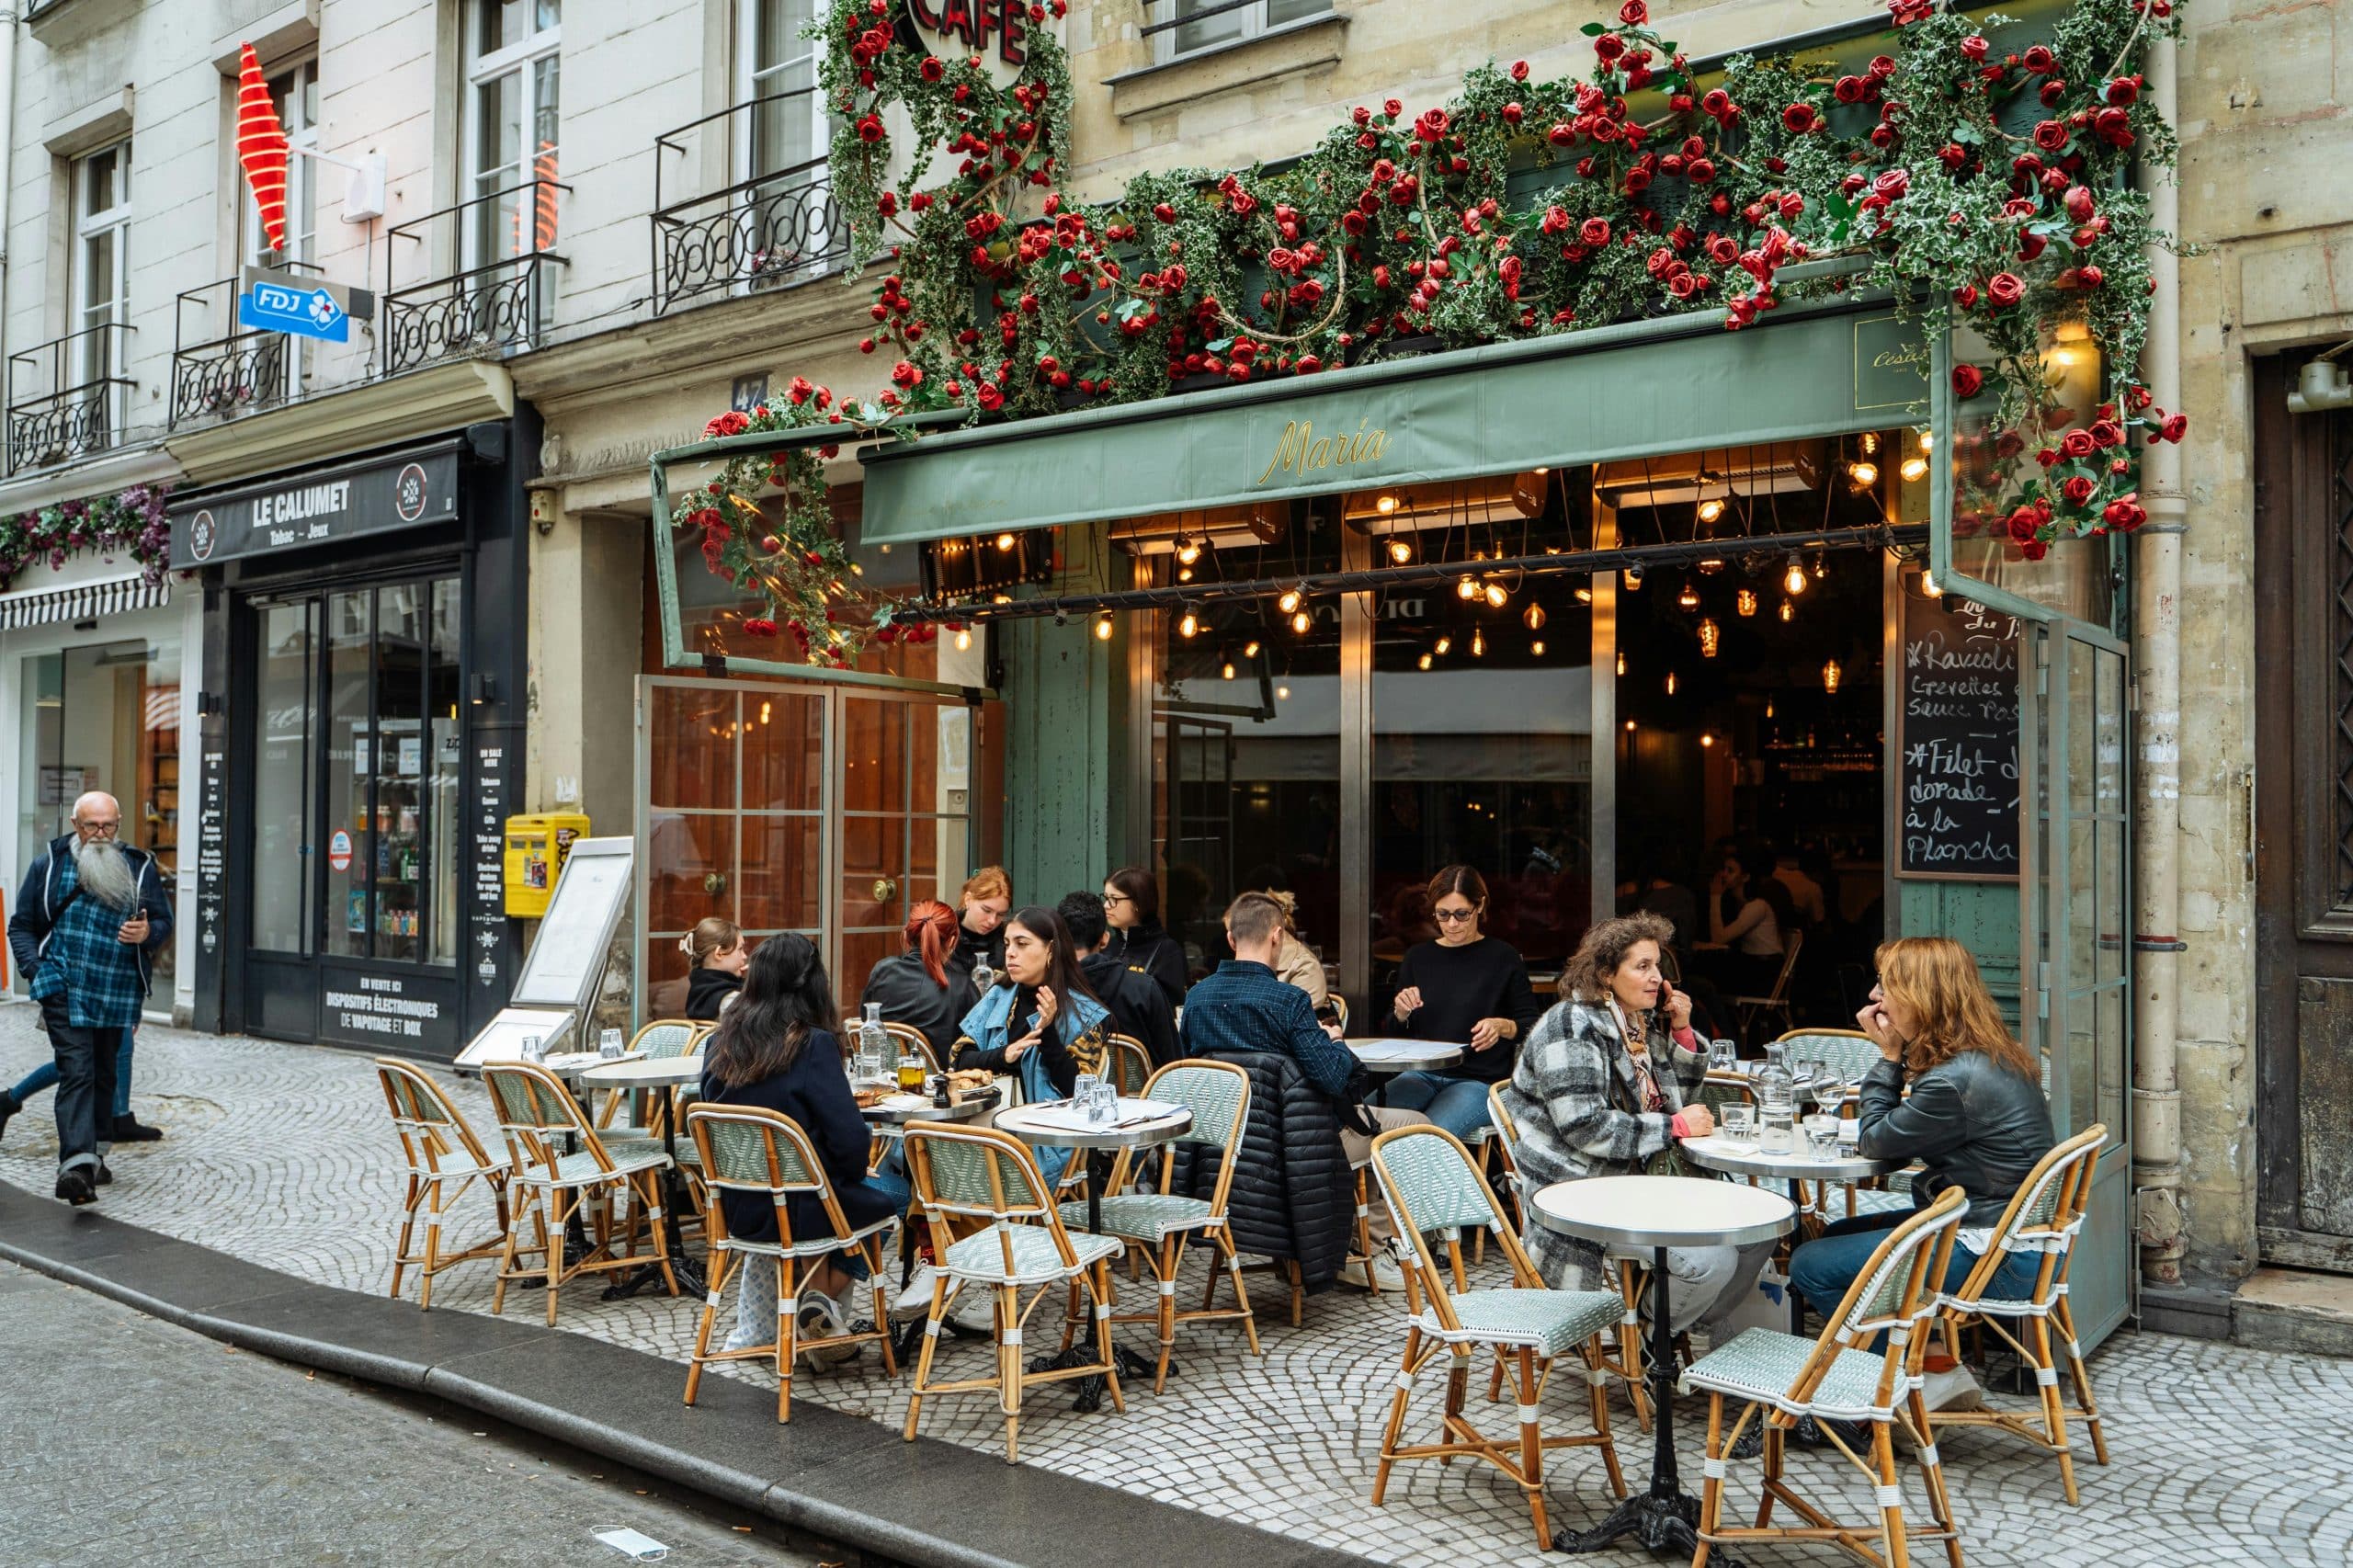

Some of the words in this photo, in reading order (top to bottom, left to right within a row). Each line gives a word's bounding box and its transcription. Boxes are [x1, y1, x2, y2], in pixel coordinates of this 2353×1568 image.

[259, 289, 301, 312] FDJ
[735, 380, 764, 411] 47
[1257, 417, 1393, 485] María
[253, 495, 271, 528] LE
[275, 480, 350, 524] CALUMET
[270, 529, 294, 547] Tabac
[307, 522, 329, 540] Jeux
[1926, 630, 2016, 672] Ravioli
[1930, 738, 1996, 777] Filet
[1910, 774, 1996, 802] dorade
[1905, 806, 1927, 828] à
[1931, 805, 1962, 833] la
[360, 977, 369, 990] EN
[370, 978, 391, 992] VENTE
[392, 981, 402, 993] ICI
[326, 992, 372, 1011] DISPOSITIFS
[373, 994, 438, 1019] ÉLECTRONIQUES
[341, 1013, 351, 1028] DE
[352, 1014, 392, 1033] VAPOTAGE
[392, 1018, 403, 1034] ET
[404, 1020, 422, 1037] BOX
